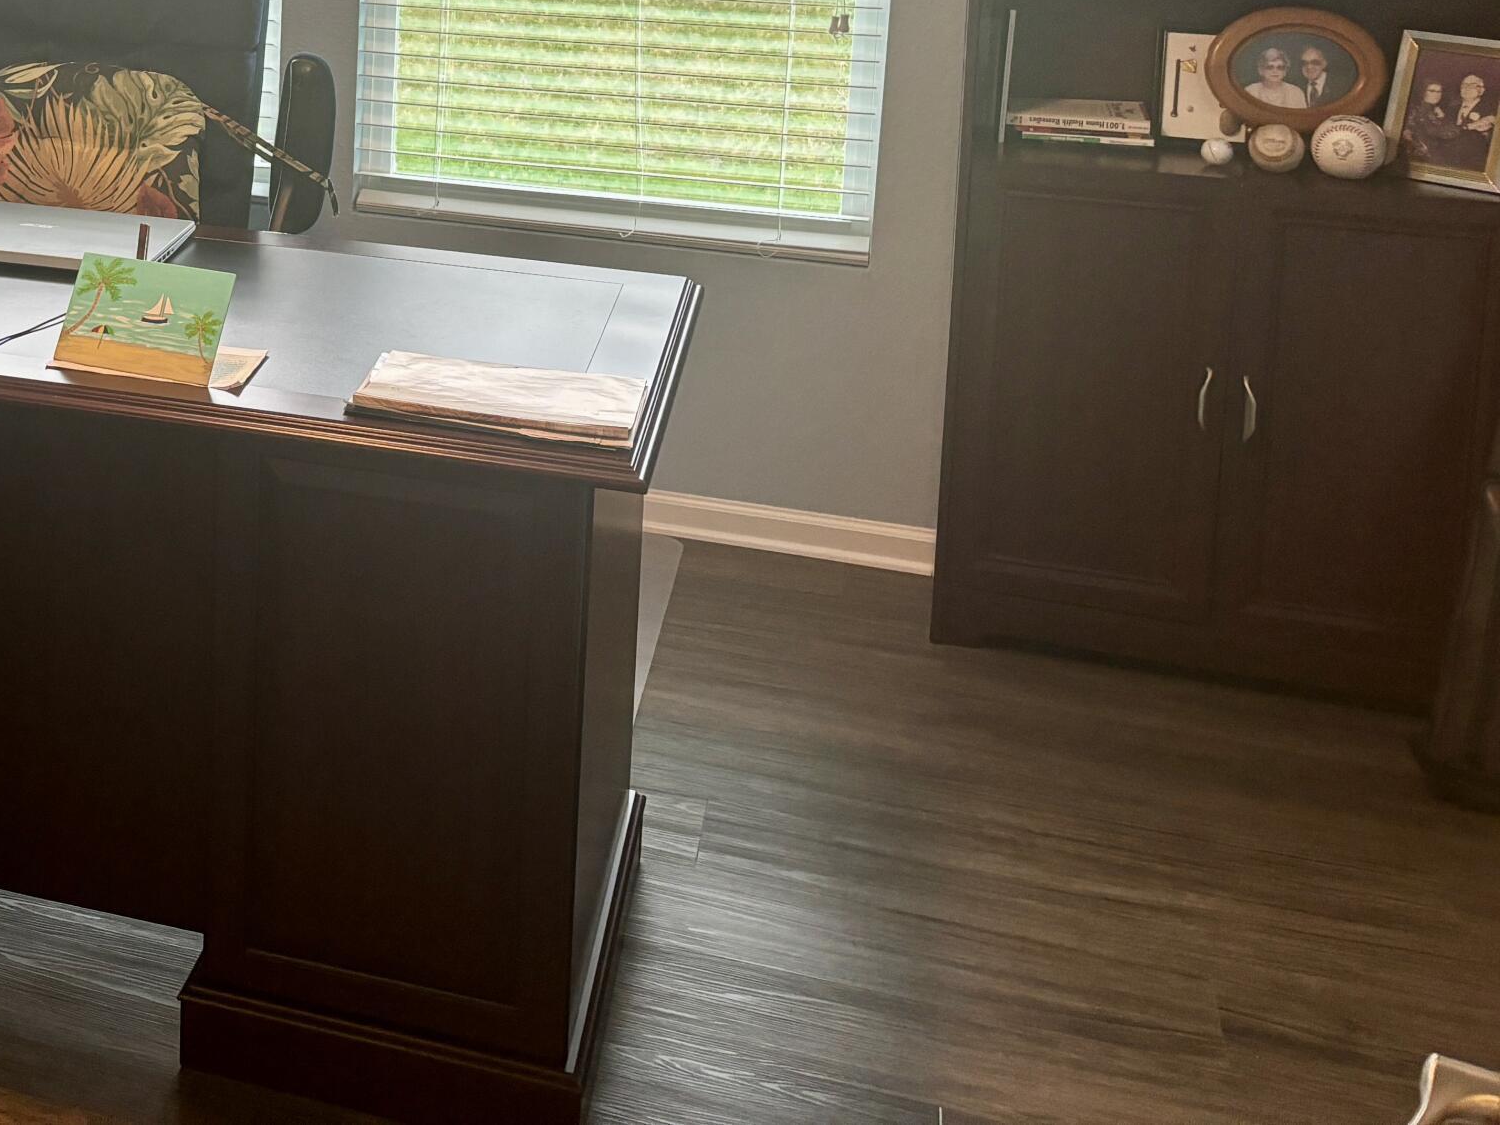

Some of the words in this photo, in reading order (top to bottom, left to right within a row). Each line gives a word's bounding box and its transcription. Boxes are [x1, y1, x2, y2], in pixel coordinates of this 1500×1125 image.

[1029, 116, 1060, 126] Remedies
[1062, 118, 1084, 128] Health
[1086, 120, 1105, 129] Home
